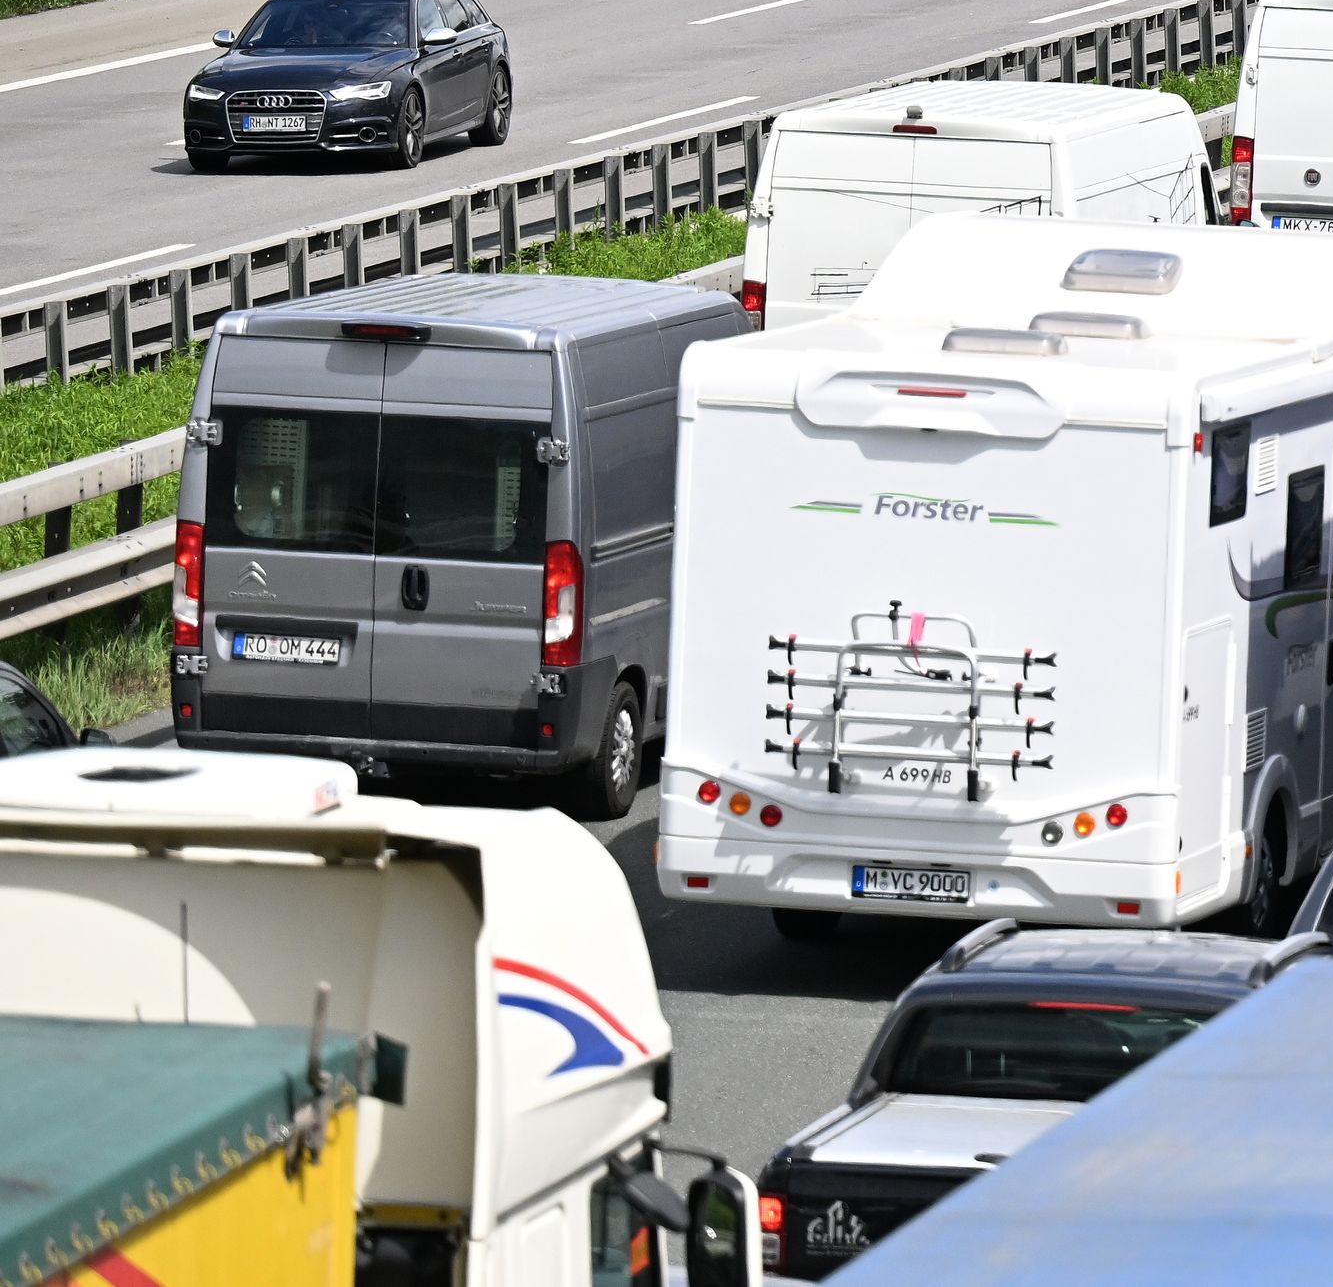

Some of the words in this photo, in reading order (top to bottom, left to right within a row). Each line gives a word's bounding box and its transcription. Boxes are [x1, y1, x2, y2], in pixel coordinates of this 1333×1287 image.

[249, 117, 261, 128] RH
[267, 117, 279, 128] NT
[282, 117, 304, 128] 1267
[874, 495, 985, 523] Forster
[245, 635, 268, 653] RO
[280, 638, 301, 656] OM
[305, 640, 337, 659] 444
[882, 766, 894, 780] A
[865, 871, 878, 889] M
[890, 871, 915, 891] YC
[919, 874, 966, 893] 9000
